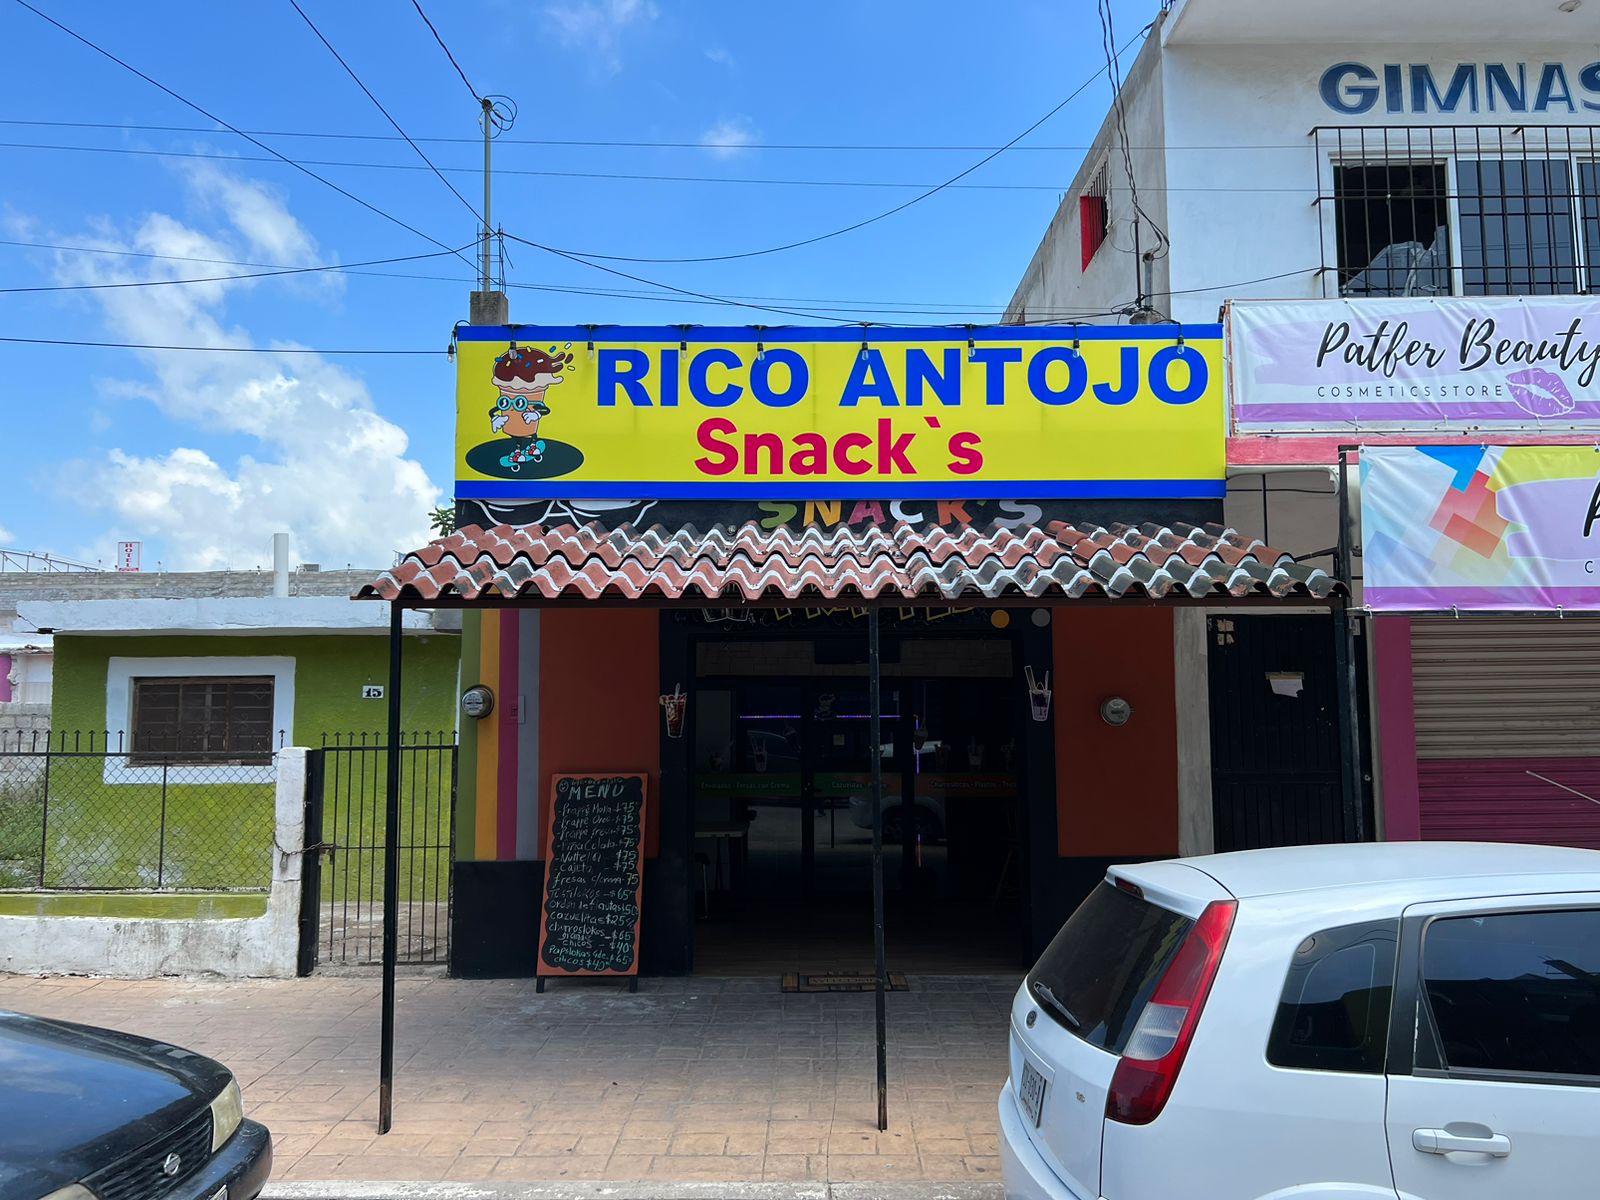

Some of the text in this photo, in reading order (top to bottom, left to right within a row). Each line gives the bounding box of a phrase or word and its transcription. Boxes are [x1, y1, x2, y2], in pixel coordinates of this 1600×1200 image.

[1316, 318, 1600, 388] Patfer Beauty
[597, 346, 1209, 407] RICO ANTOJO
[1317, 384, 1503, 398] COSMETICS STORE
[124, 543, 133, 567] HOTEL
[568, 783, 625, 801] MENU
